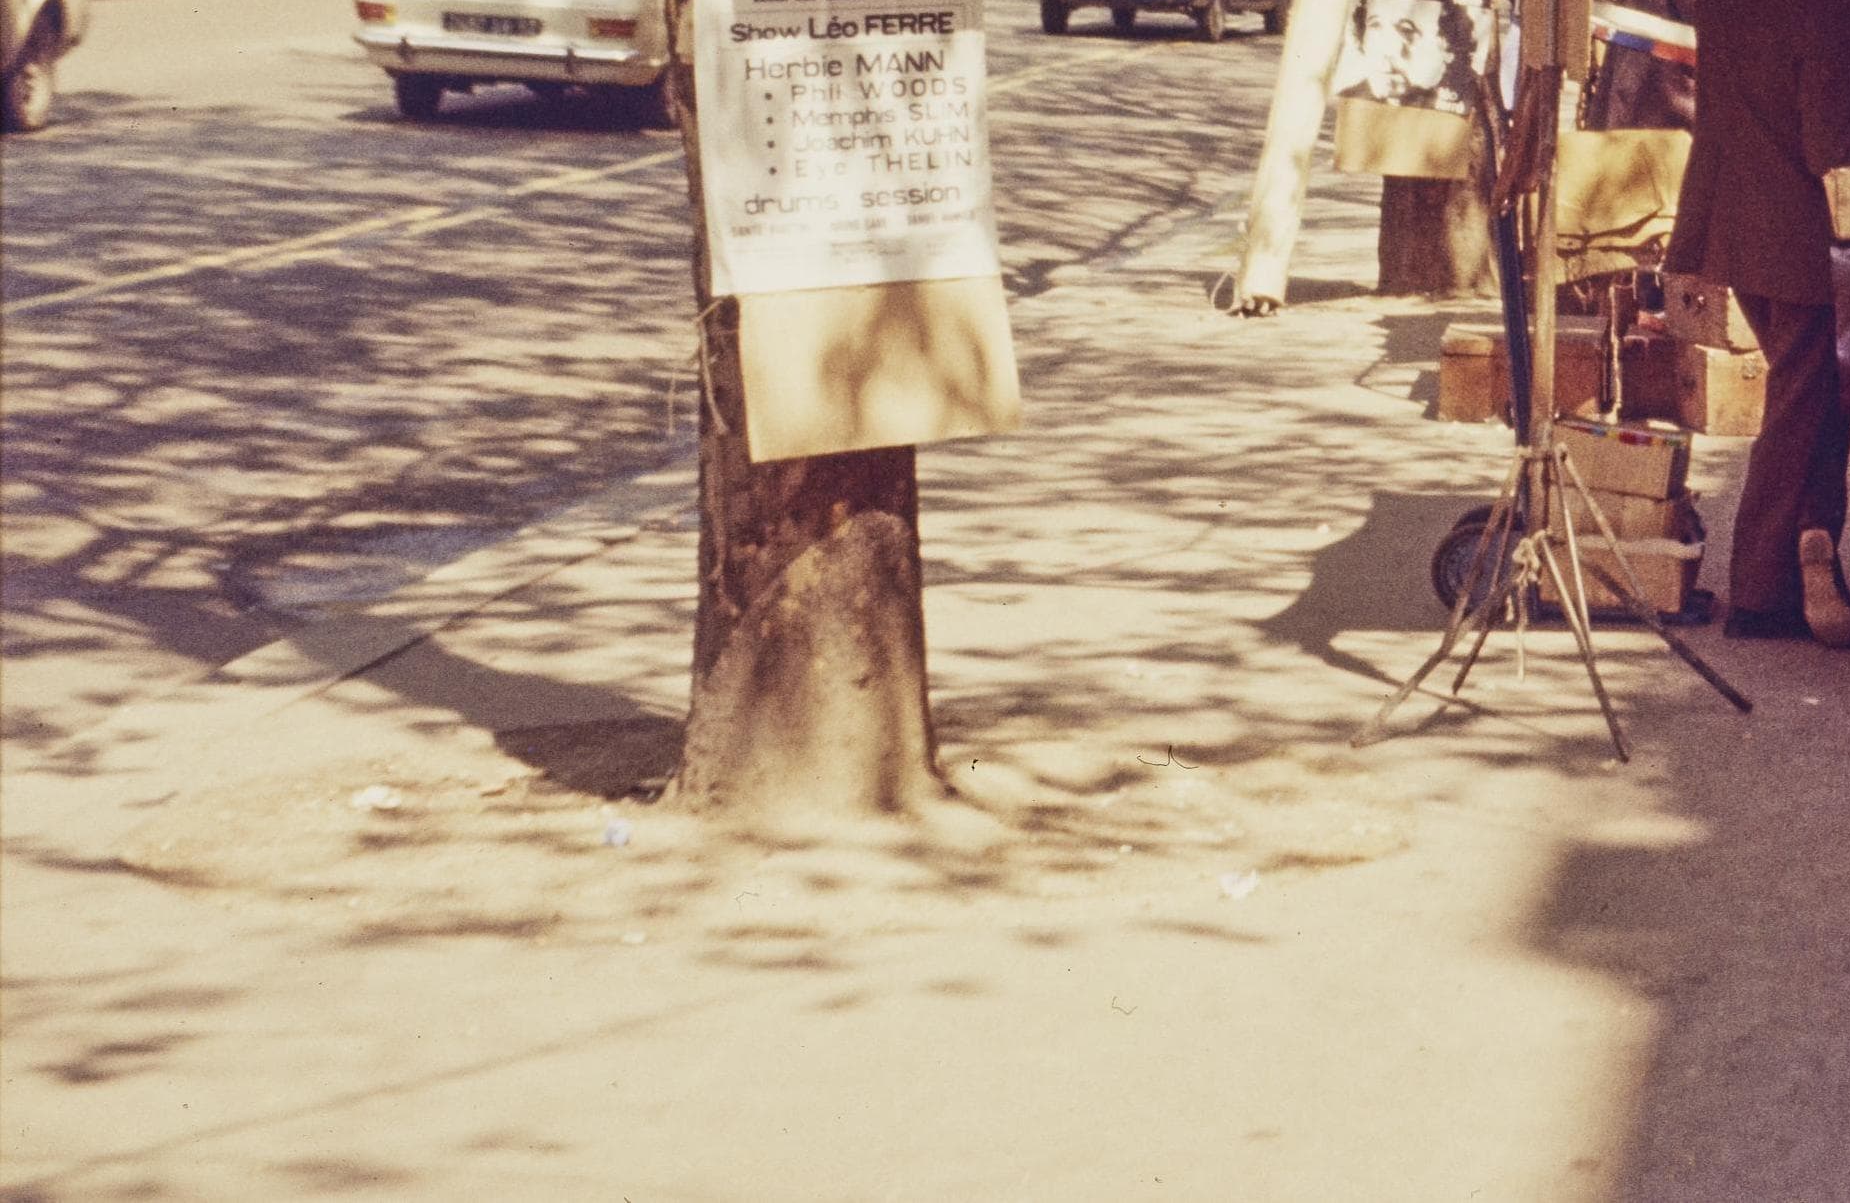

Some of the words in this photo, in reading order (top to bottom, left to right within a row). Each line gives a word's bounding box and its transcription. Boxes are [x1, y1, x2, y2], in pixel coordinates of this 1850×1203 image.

[730, 21, 801, 43] Show
[808, 15, 859, 39] Léo
[864, 11, 955, 36] FERRE
[744, 58, 842, 81] Herbie
[856, 49, 945, 74] MANN
[790, 79, 848, 103] Phil
[859, 76, 968, 99] WOODS
[791, 106, 896, 129] Memphis
[909, 101, 970, 122] SLIM
[793, 131, 893, 153] Joachim
[868, 150, 973, 173] THELIN
[744, 193, 839, 216] drums
[860, 184, 960, 208] session
